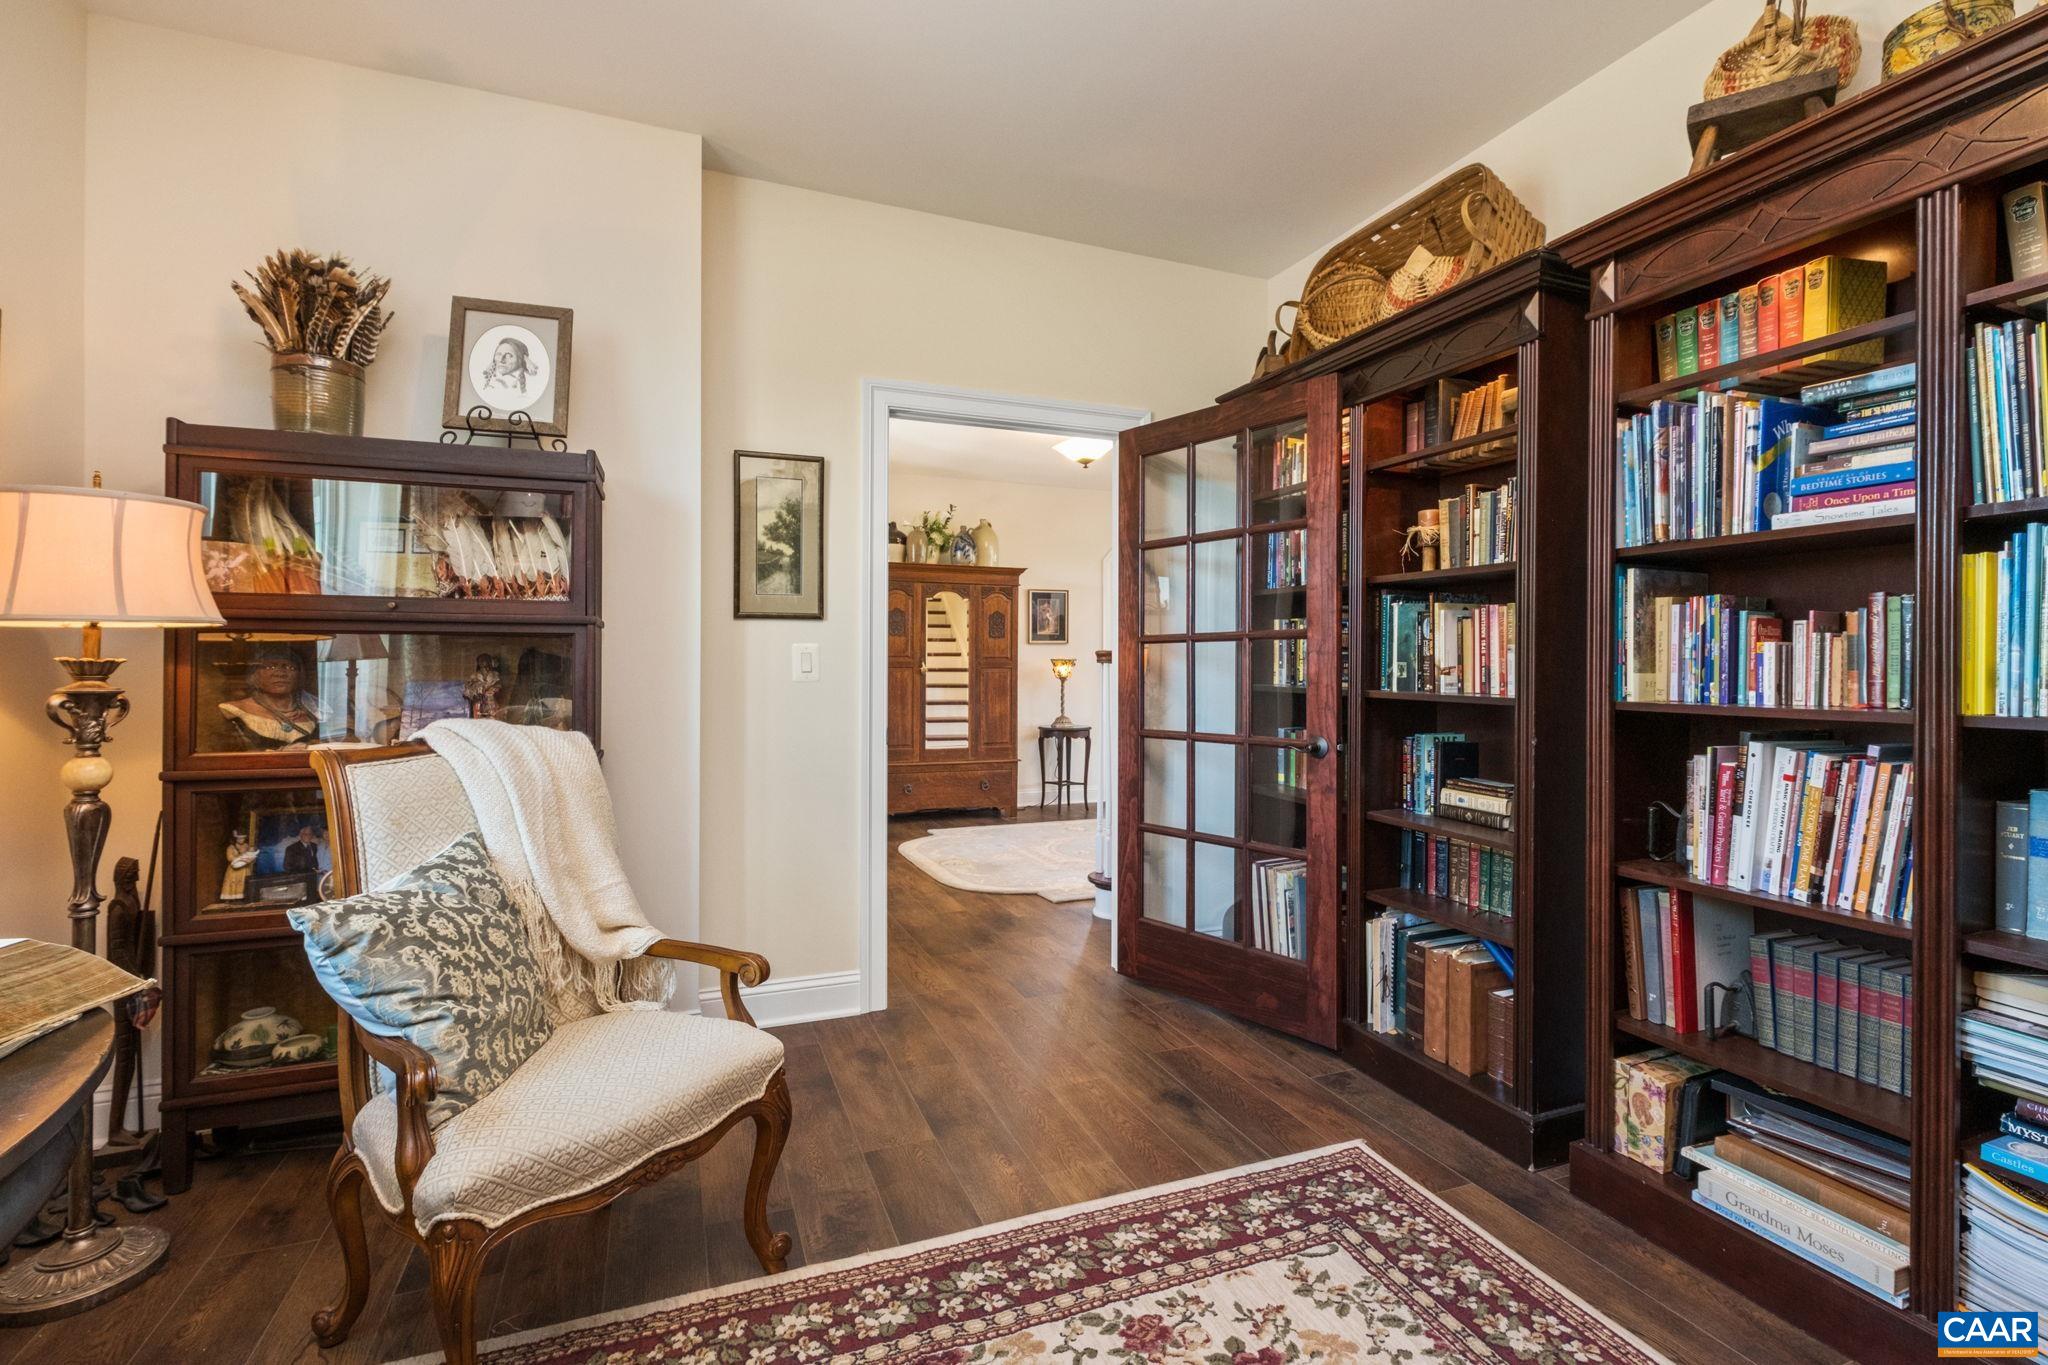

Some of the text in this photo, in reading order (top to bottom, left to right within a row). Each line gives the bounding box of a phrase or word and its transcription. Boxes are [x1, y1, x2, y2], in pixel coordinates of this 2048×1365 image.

[2018, 362, 2027, 382] WORLD
[1800, 473, 1887, 491] BEDTIME STORIES
[1824, 495, 1850, 506] Once
[1853, 492, 1881, 505] Upon
[1813, 505, 1899, 524] Snowtime Tales
[1720, 788, 1729, 803] Yard
[1781, 783, 1790, 799] BASIC
[1745, 789, 1754, 828] CHEROKEE
[1778, 801, 1787, 827] POTTERY
[1717, 812, 1727, 835] Garden
[1714, 835, 1724, 862] Projects
[1775, 828, 1784, 853] MAKING
[1800, 801, 1817, 890] 2-STORY HOME PLANS
[1991, 1151, 2035, 1174] Castles
[1715, 1203, 1733, 1220] Read
[1784, 1197, 1810, 1213] MOST
[1810, 1210, 1859, 1239] BEAUTIFUL
[1725, 1191, 1791, 1236] Grandma
[1796, 1227, 1846, 1263] Moses
